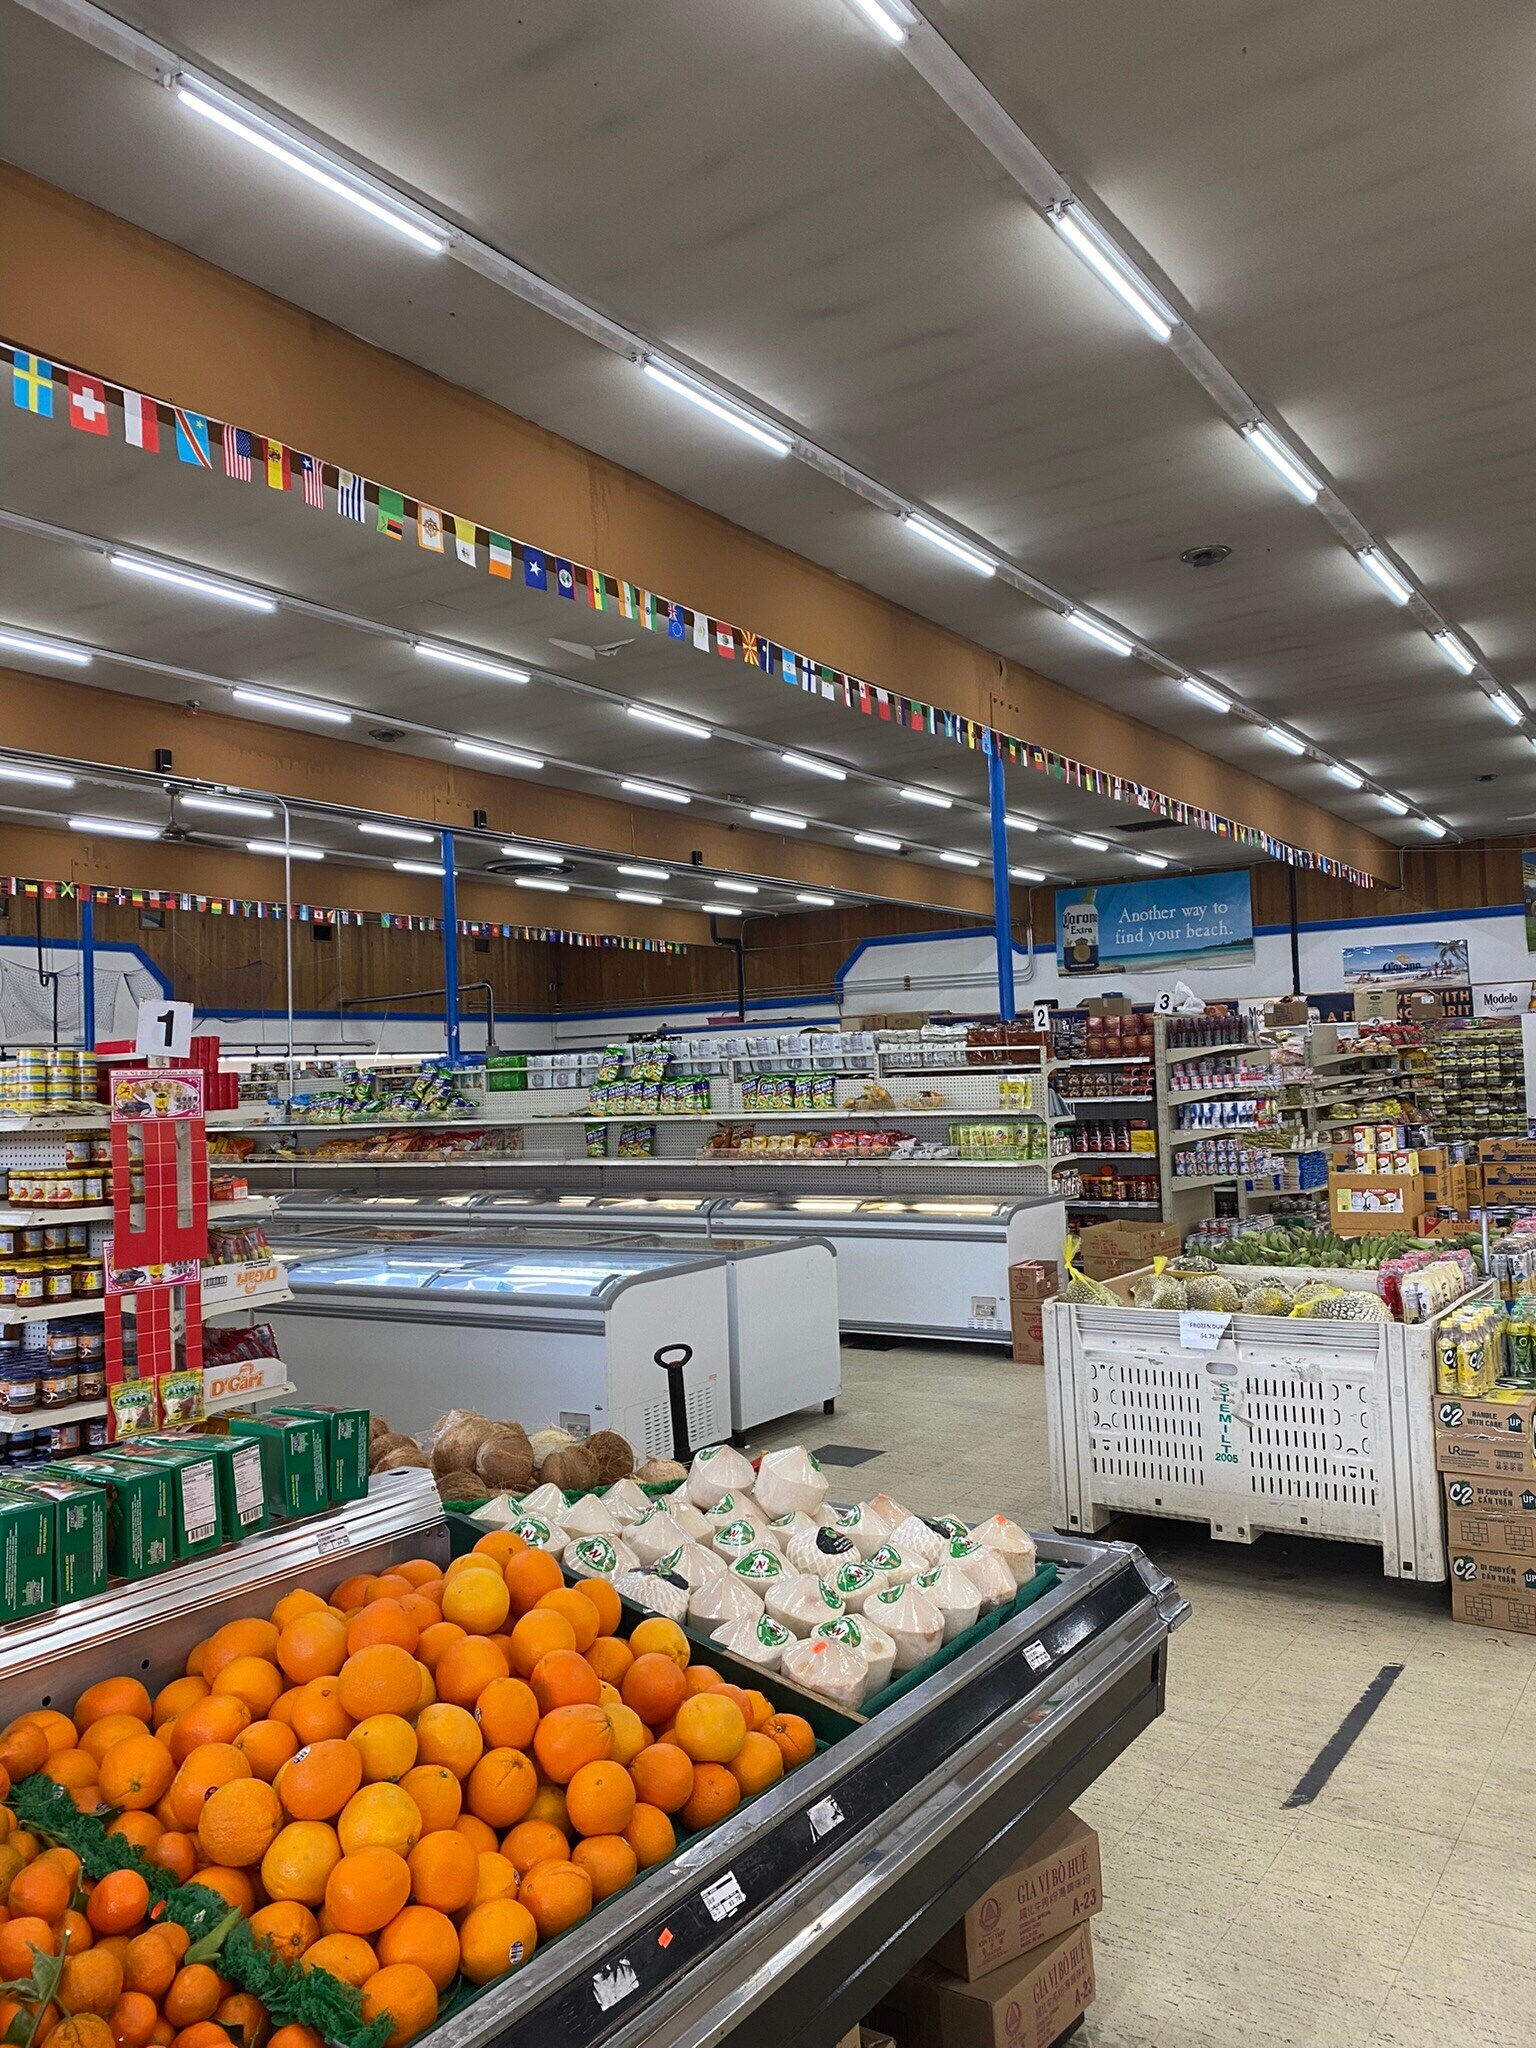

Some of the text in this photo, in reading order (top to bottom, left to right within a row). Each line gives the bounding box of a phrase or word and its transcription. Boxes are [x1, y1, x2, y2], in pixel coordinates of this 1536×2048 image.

[1118, 902, 1228, 924] Another way to
[1071, 925, 1093, 935] Extra
[1115, 920, 1233, 947] find your beach.
[1159, 994, 1170, 1010] 3
[1484, 993, 1518, 1006] Modelo
[157, 1010, 175, 1047] 1
[1037, 1009, 1046, 1027] 2
[210, 1371, 264, 1398] D'Gari
[1219, 1383, 1232, 1453] STEMILT
[1439, 1404, 1464, 1426] C2
[1467, 1418, 1503, 1428] WITH CARE
[1471, 1411, 1498, 1420] HANDLE
[1509, 1418, 1521, 1426] UP
[1215, 1453, 1239, 1464] 2005
[1450, 1483, 1474, 1506] C2
[1522, 1495, 1534, 1504] UP
[1453, 1558, 1477, 1580] C2
[1051, 1860, 1066, 1887] BÒ
[1067, 1846, 1089, 1879] HUẾ
[1072, 1888, 1097, 1916] A-23
[1075, 1976, 1093, 2008] A-23
